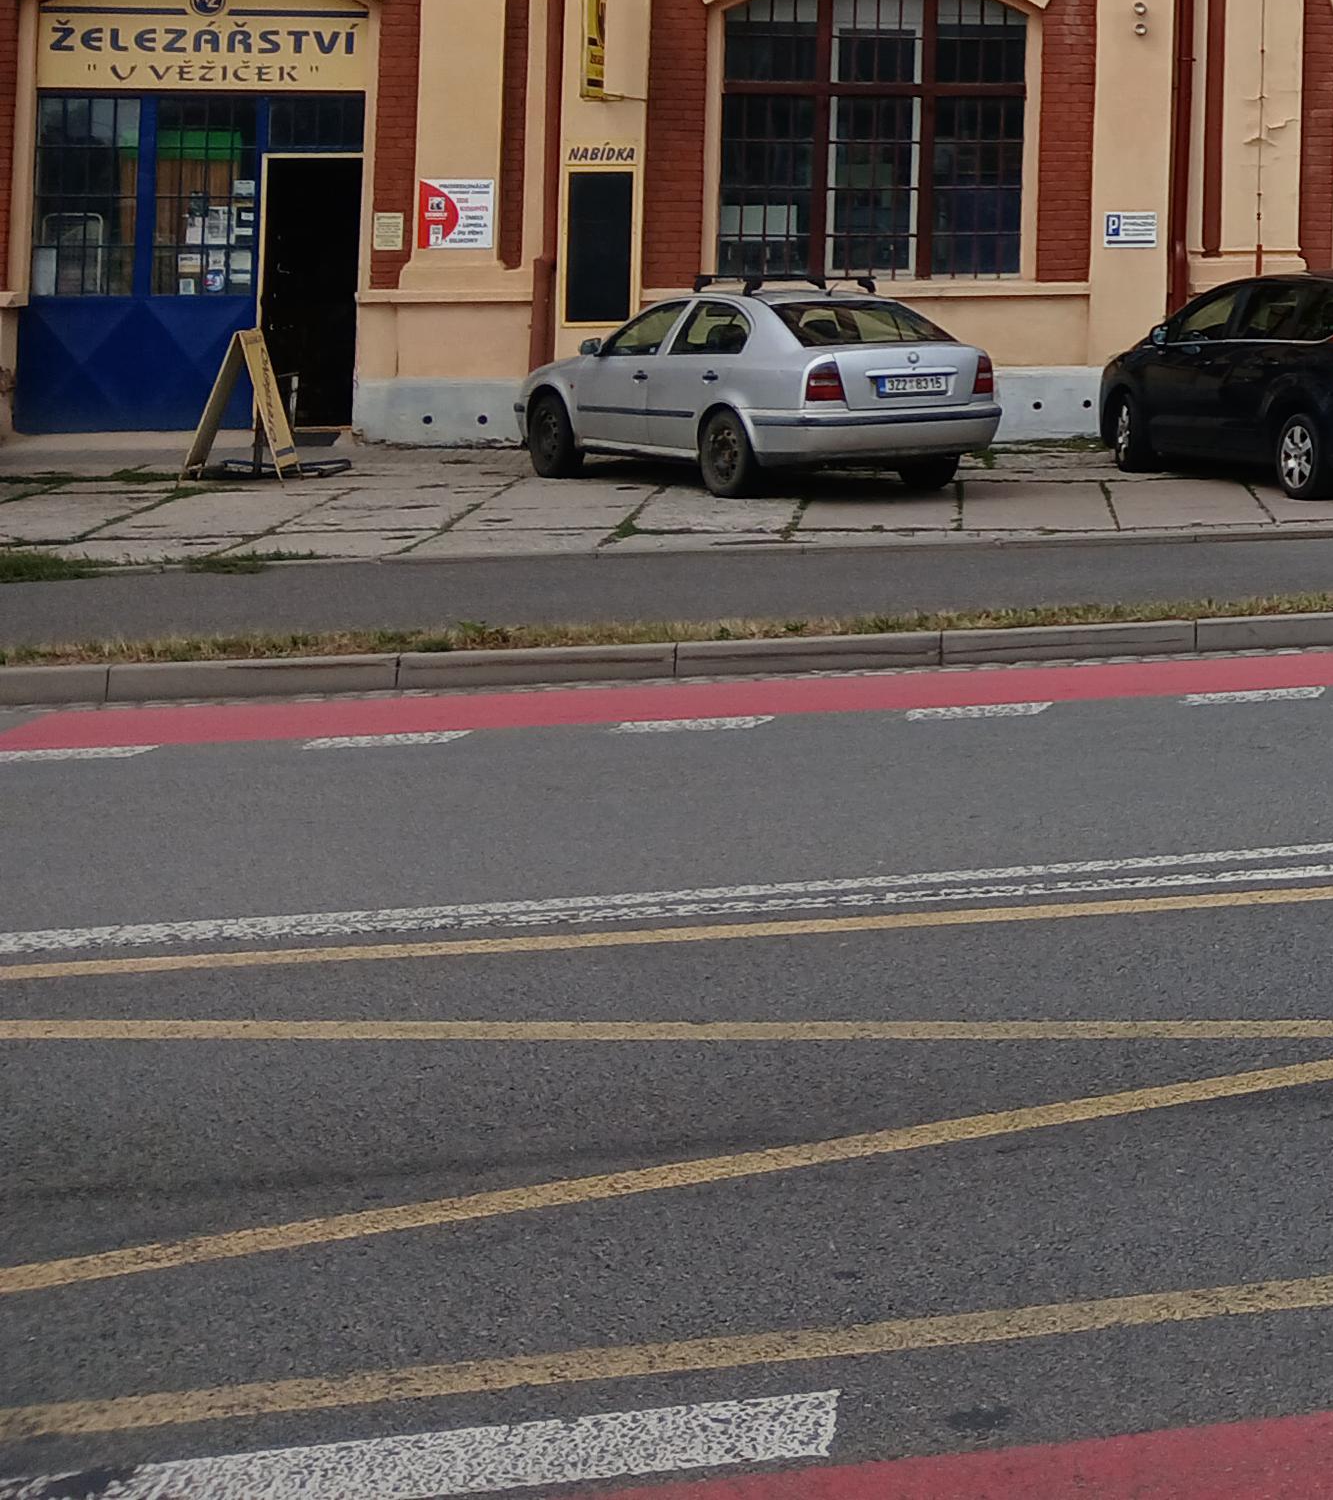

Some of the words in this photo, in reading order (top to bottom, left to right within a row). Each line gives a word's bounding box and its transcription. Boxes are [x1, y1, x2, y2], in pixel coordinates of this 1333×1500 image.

[50, 20, 358, 55] ŽELEZÁŘSTVÍ
[148, 59, 299, 82] VĚŽIČEK
[568, 141, 636, 162] NABÍDKA
[1108, 216, 1119, 235] P
